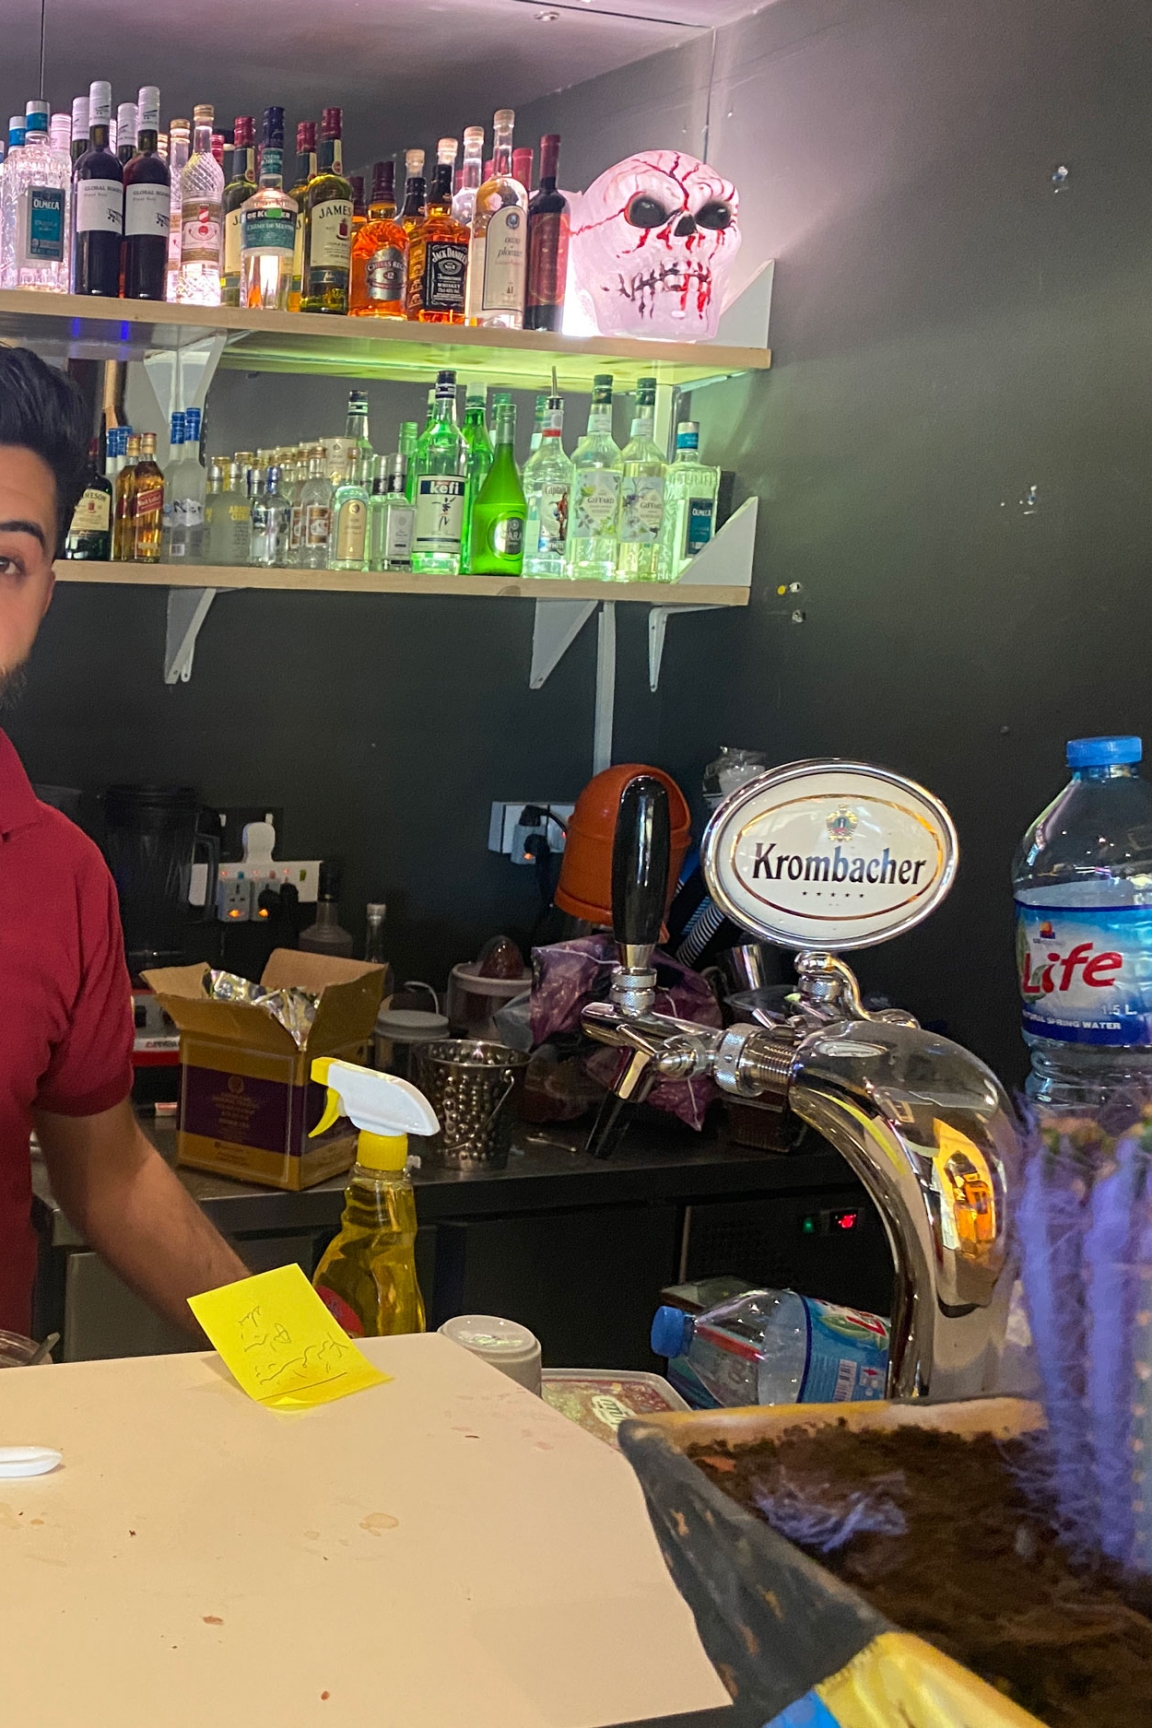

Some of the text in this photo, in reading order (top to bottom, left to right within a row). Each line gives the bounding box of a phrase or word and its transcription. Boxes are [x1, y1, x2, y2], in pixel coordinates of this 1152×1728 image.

[33, 199, 60, 211] OLMECA
[257, 210, 291, 219] KER
[430, 480, 459, 495] kefi
[751, 842, 927, 886] Krombacher
[1021, 942, 1123, 994] Life
[1124, 1003, 1138, 1015] L
[1046, 1017, 1080, 1028] SPRING
[1082, 1020, 1122, 1030] WATER
